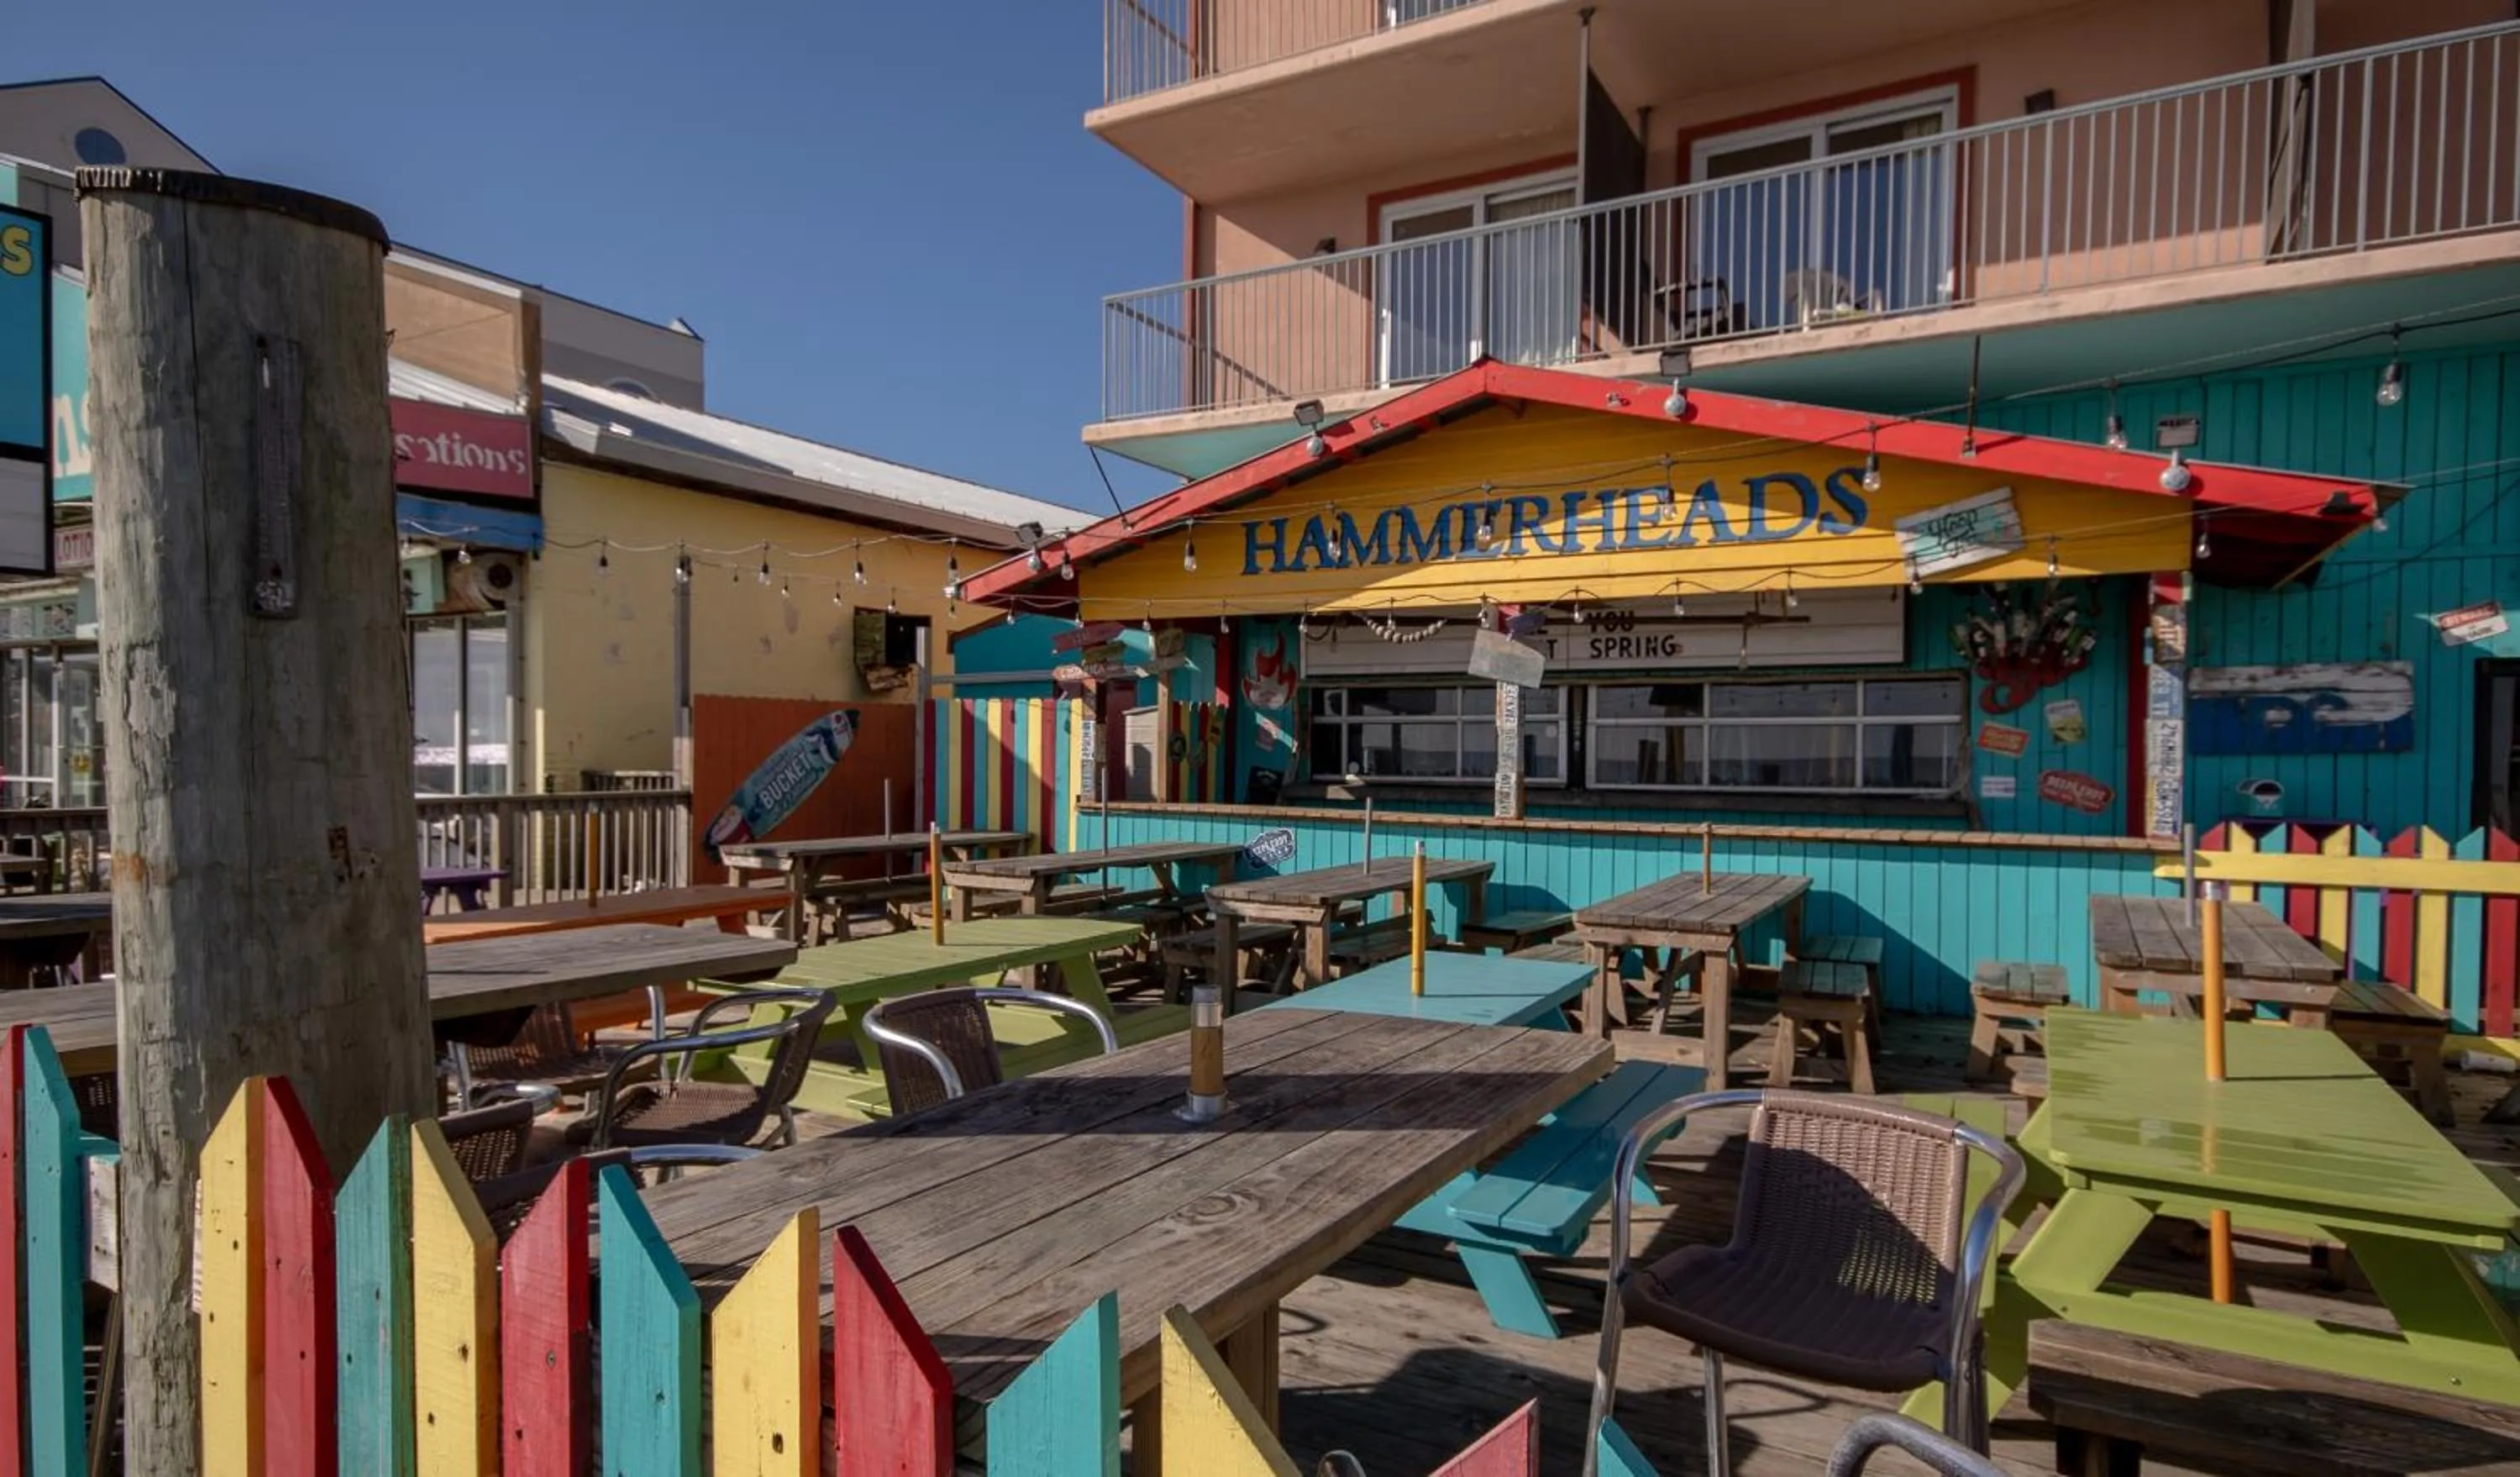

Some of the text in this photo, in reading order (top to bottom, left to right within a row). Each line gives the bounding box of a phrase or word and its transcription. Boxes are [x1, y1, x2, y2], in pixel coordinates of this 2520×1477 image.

[1241, 467, 1868, 576] HAMMERHEADS
[55, 531, 93, 561] LOTIO
[1587, 611, 1635, 633] YOU
[1589, 634, 1676, 660] SPRING
[759, 752, 812, 809] BUCKET
